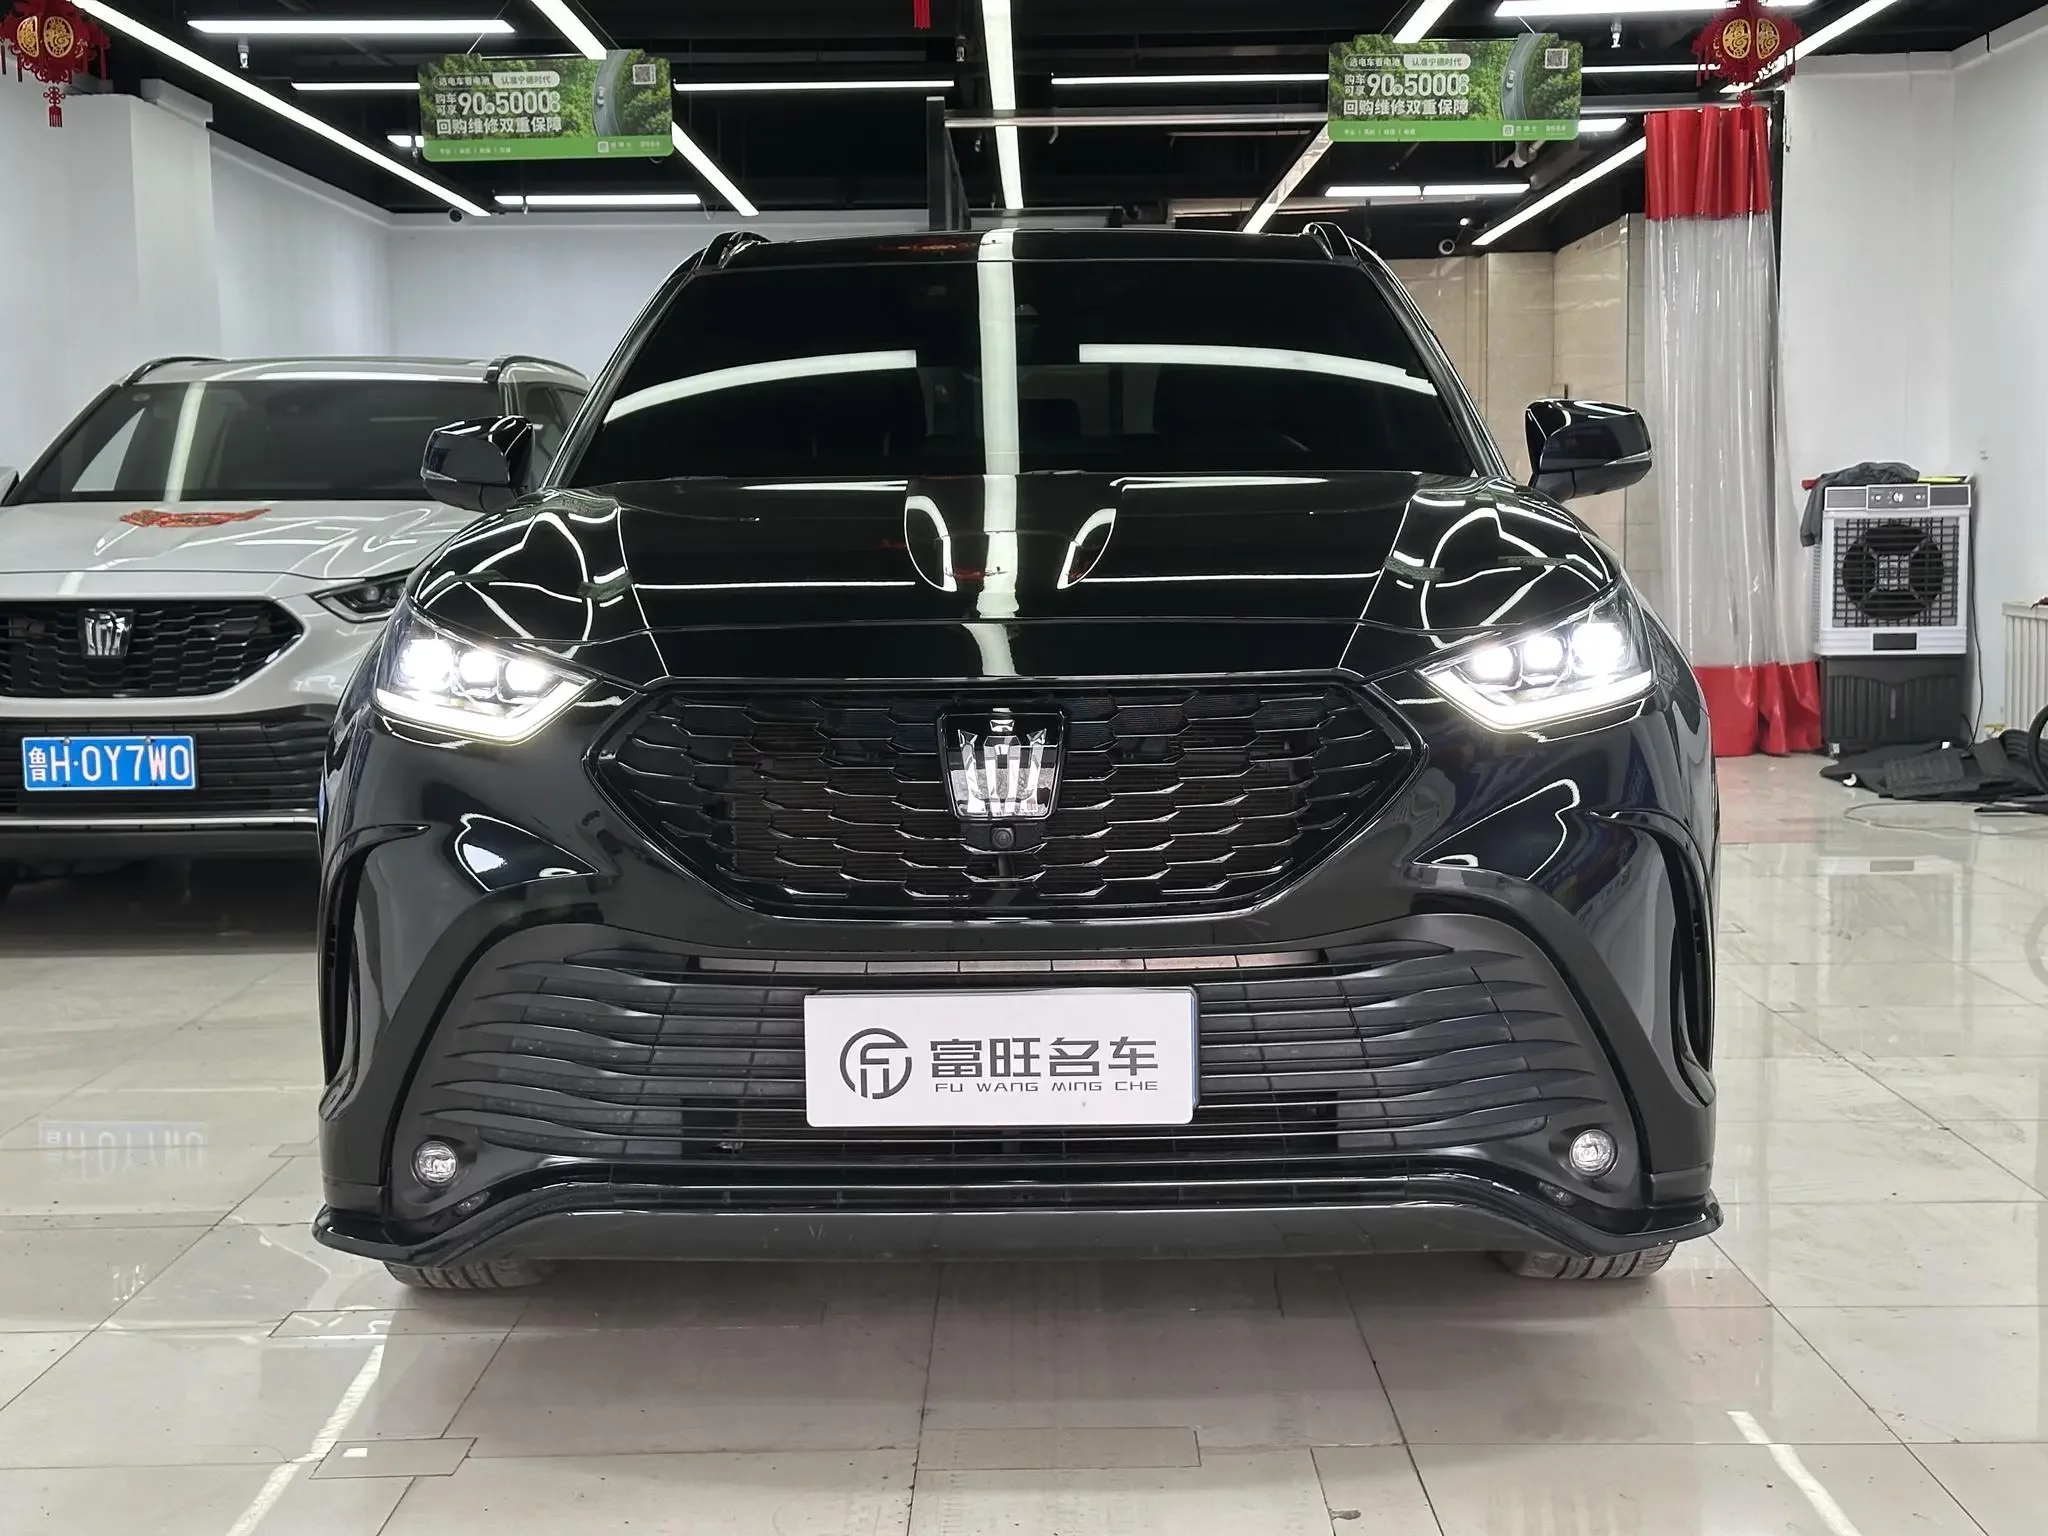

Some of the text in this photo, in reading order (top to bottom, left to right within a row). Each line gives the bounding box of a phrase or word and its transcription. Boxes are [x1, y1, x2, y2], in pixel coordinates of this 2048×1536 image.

[1344, 73, 1366, 85] 购车
[1343, 99, 1469, 116] 回购维修双重保障
[436, 117, 562, 135] 回购维修双重保障
[930, 1036, 1159, 1078] 富旺名车
[935, 1081, 1158, 1093] FU WANG MING CHE
